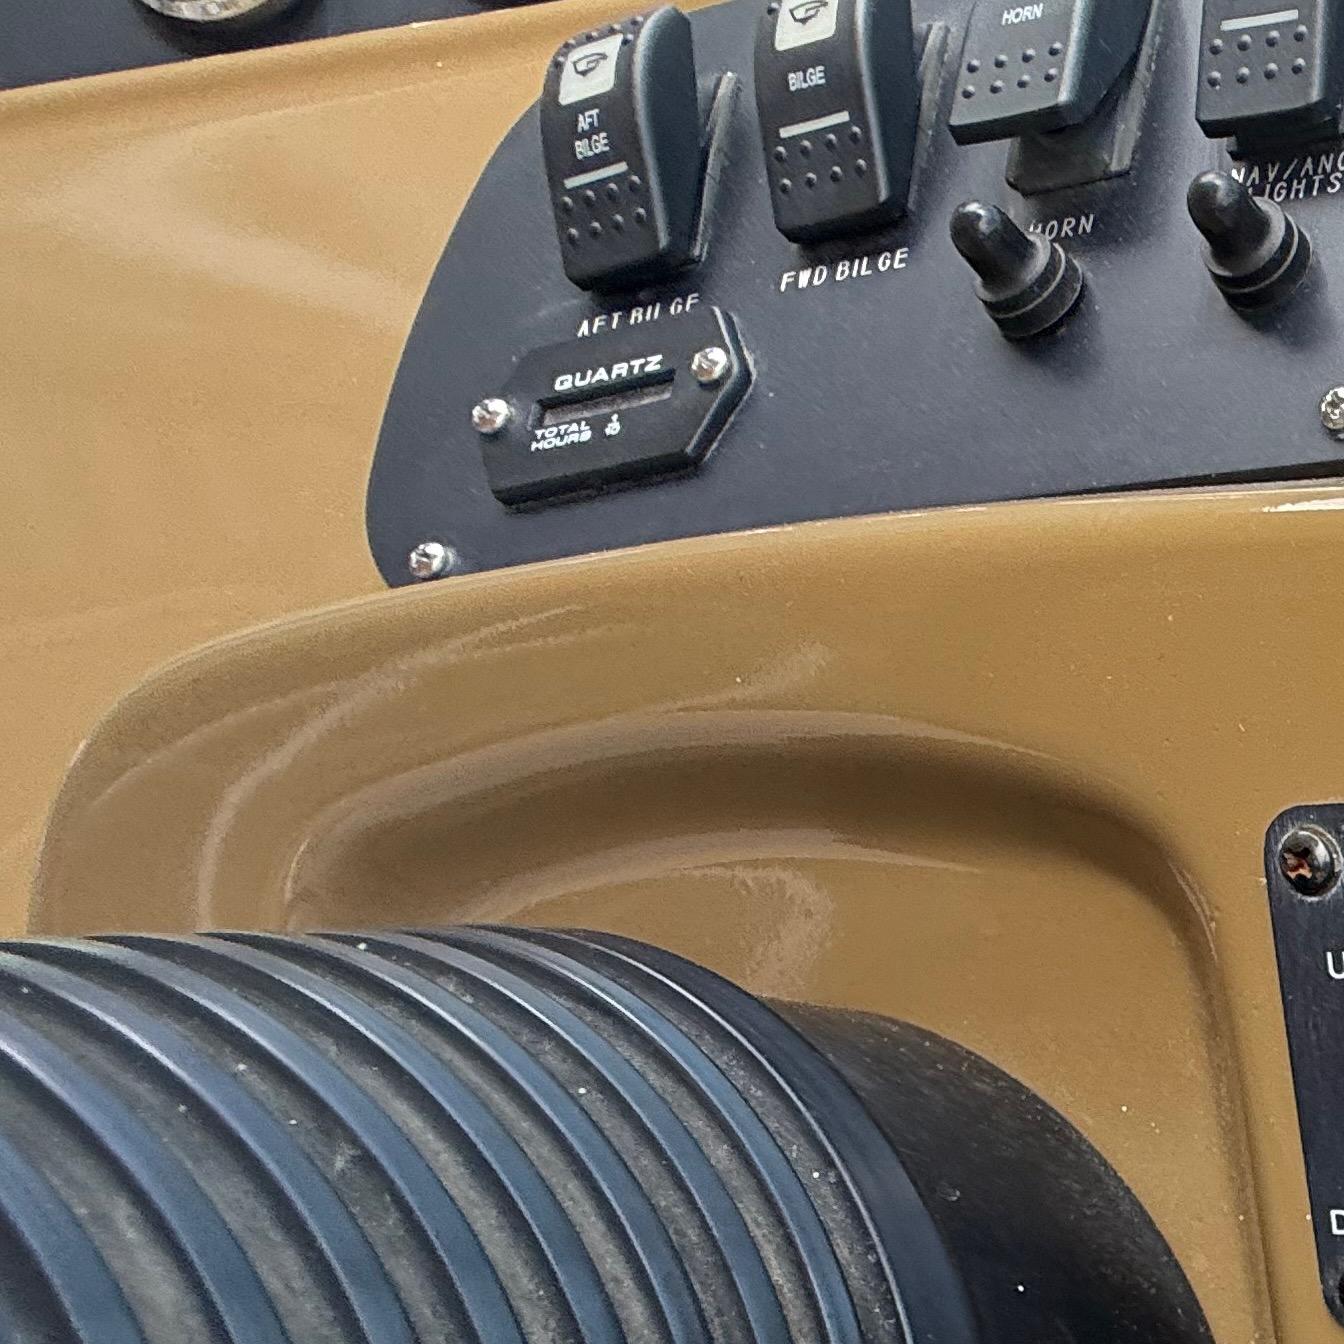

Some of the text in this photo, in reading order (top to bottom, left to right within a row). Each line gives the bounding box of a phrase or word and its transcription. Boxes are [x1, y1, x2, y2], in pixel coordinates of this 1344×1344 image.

[1001, 3, 1044, 26] HORN
[787, 65, 826, 92] BILGE
[577, 108, 600, 133] AFT
[574, 132, 610, 160] BILGE
[1248, 172, 1343, 203] IGHTS
[780, 248, 910, 293] FWD BILGE
[577, 311, 623, 338] AFT
[554, 354, 664, 392] QUARTZ
[530, 429, 593, 452] HOURS
[534, 420, 591, 440] TOTAL
